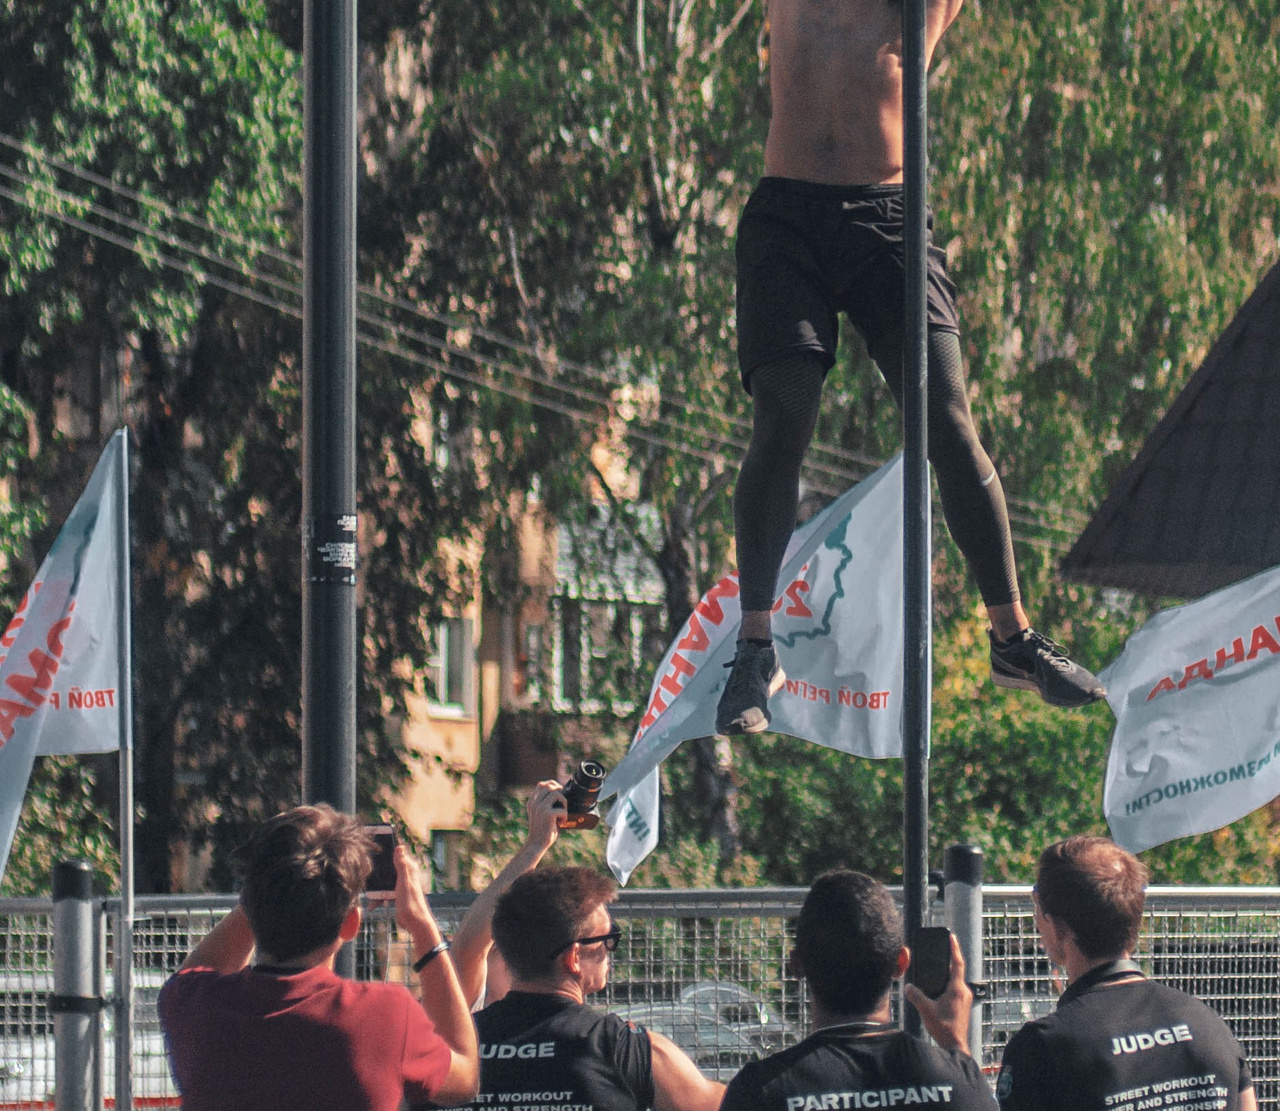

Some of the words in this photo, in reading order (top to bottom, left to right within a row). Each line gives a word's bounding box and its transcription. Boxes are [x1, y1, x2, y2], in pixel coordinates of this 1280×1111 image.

[478, 1041, 556, 1059] UDGE
[1112, 1024, 1193, 1056] JUDGE
[498, 1091, 573, 1103] WORKOUT
[787, 1086, 953, 1111] PARTICIPANT
[1105, 1086, 1150, 1106] STREET
[1152, 1074, 1216, 1094] WORKOUT
[1137, 1096, 1163, 1110] AND
[1164, 1087, 1228, 1105] STRENGTH
